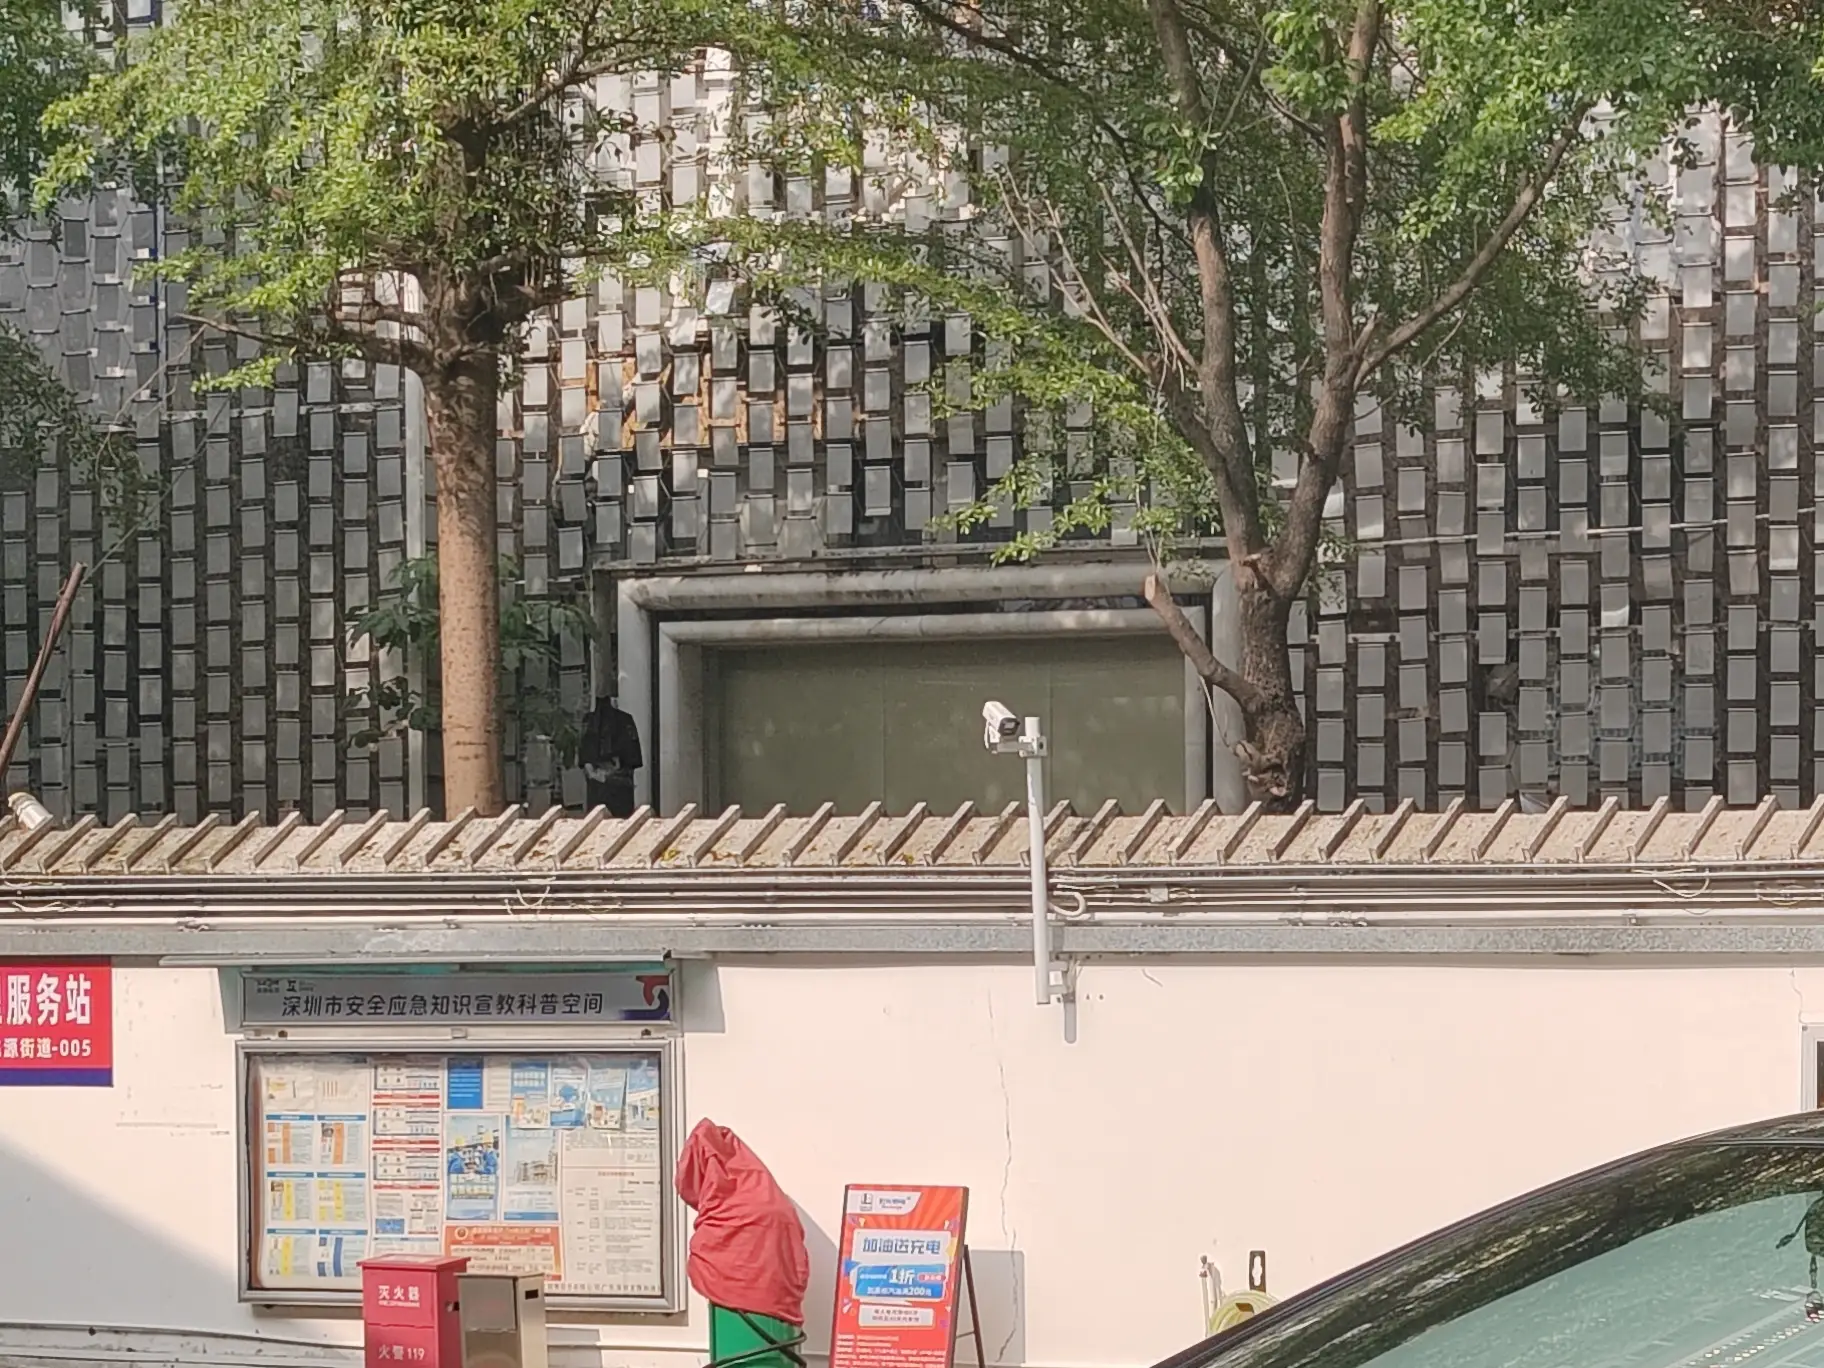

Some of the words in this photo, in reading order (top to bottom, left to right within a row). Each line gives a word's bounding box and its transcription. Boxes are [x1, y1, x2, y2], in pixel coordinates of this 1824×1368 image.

[0, 973, 91, 1025] 服务站
[282, 994, 603, 1016] 深圳市安全应急知识宣教科普空间
[0, 1037, 92, 1058] 源街道-005
[863, 1237, 941, 1254] 加油送充电
[378, 1285, 420, 1301] 灭火器
